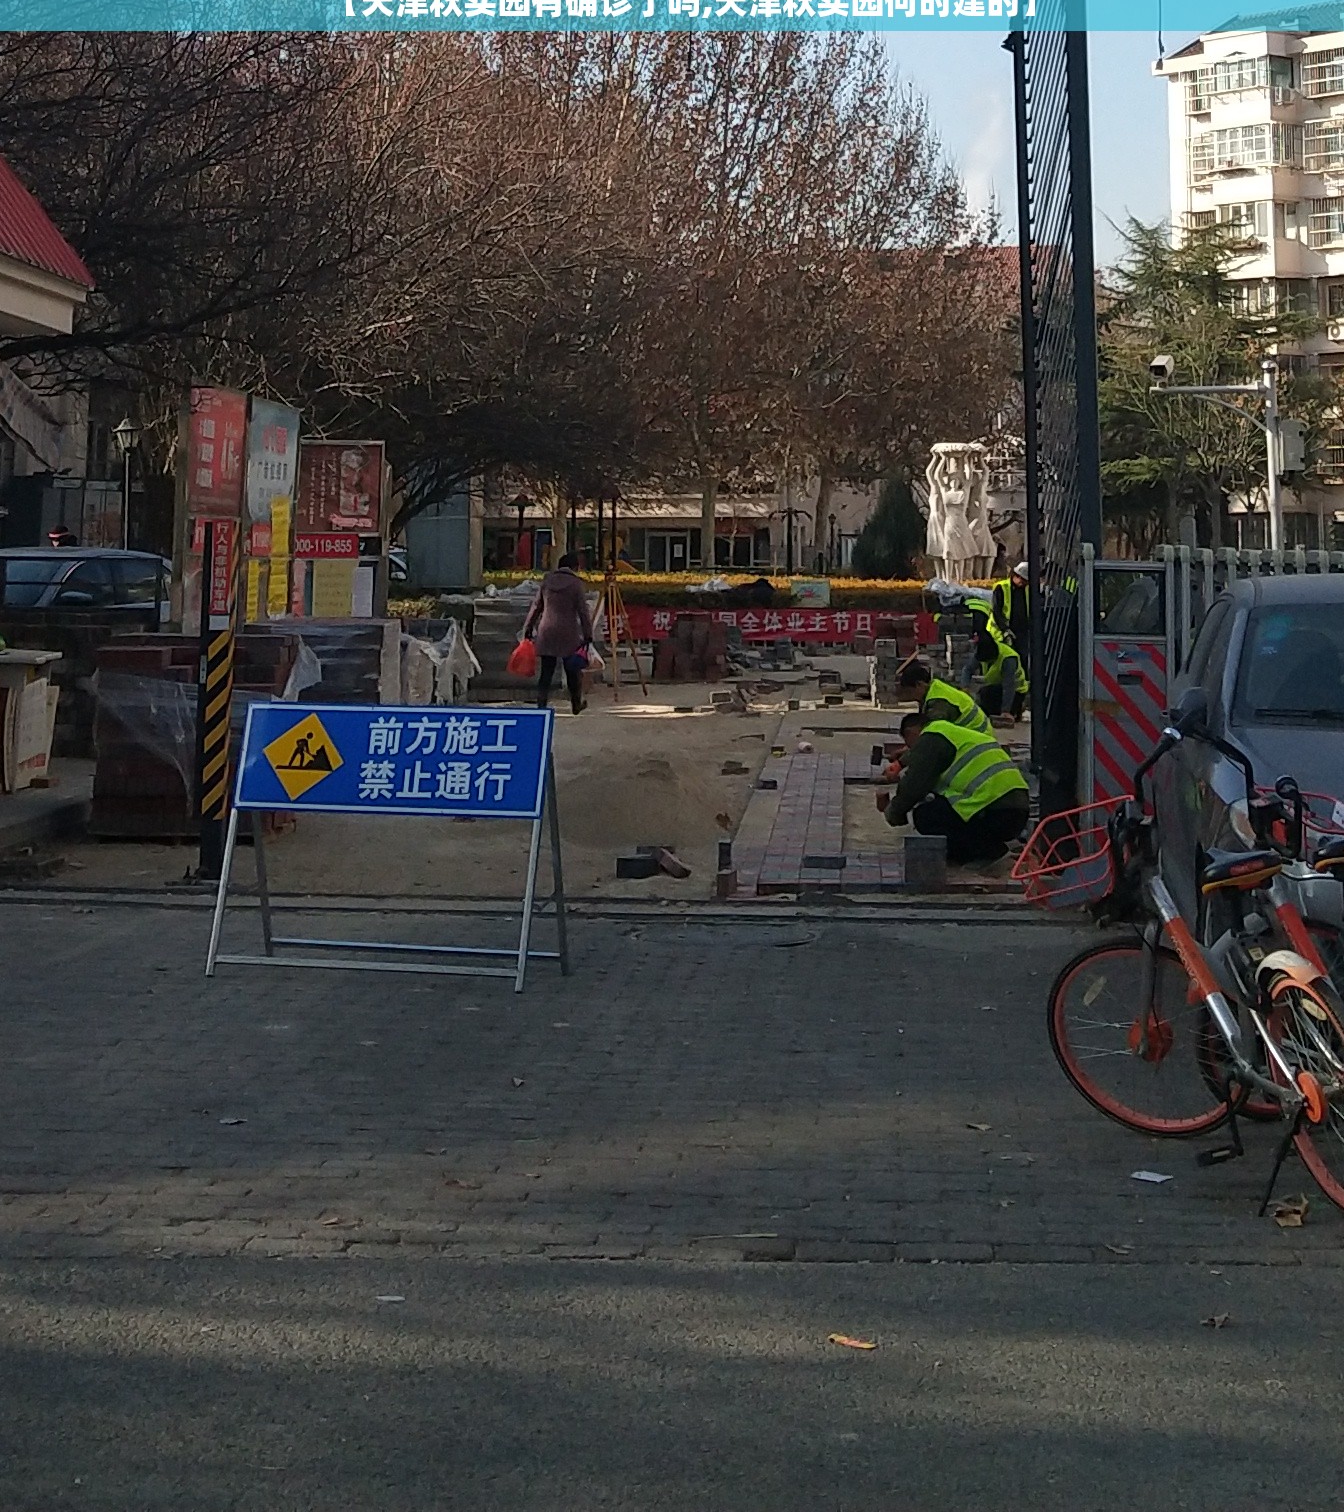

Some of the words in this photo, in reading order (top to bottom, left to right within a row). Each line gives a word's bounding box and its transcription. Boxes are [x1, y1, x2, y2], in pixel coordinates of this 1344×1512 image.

[653, 611, 919, 633] 祝园全体业主节日
[368, 716, 518, 755] 前方施工
[358, 761, 512, 801] 禁止通行
